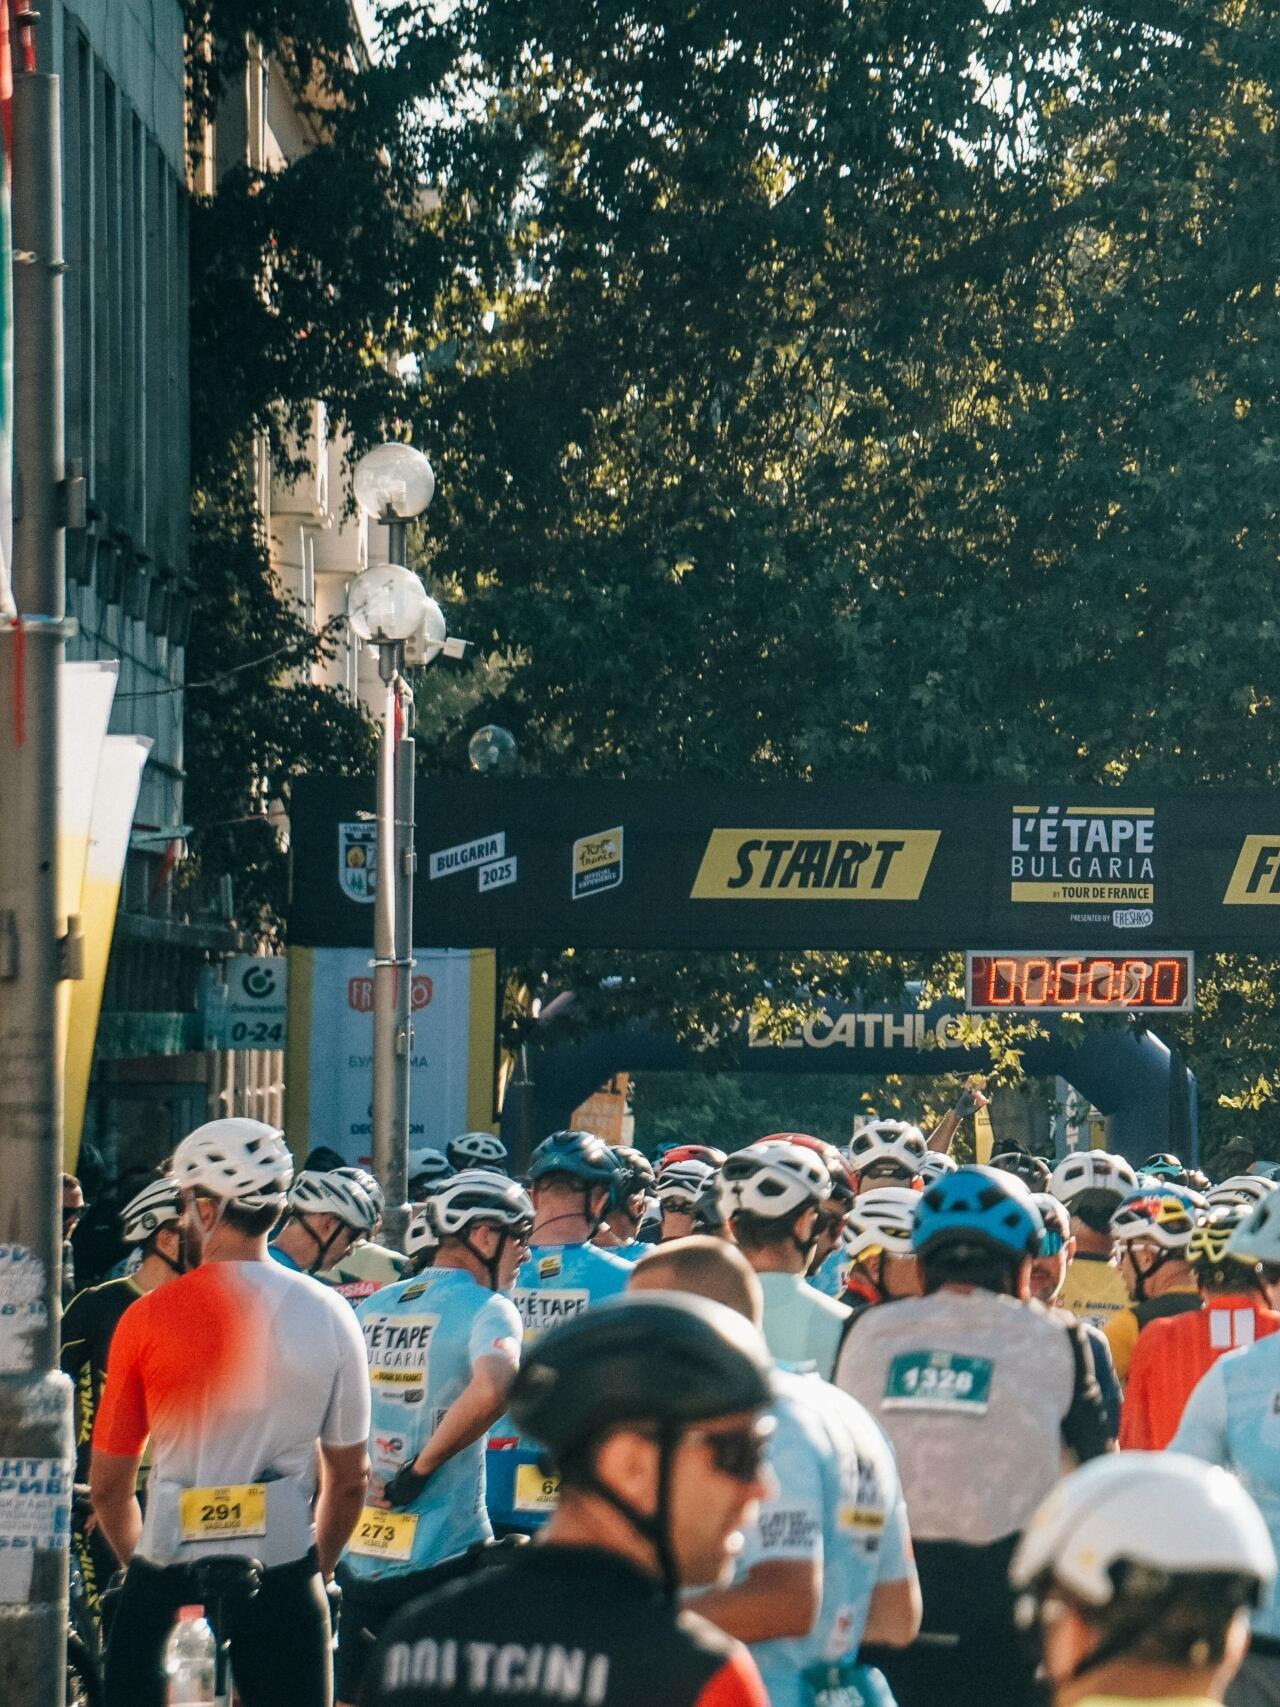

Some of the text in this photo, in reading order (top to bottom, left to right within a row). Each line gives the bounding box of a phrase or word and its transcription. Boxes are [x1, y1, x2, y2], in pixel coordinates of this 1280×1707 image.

[1012, 807, 1155, 853] L'ÉTAPE
[437, 840, 498, 872] BULGARIA
[482, 864, 513, 885] 2025
[1011, 856, 1154, 878] BULGARIA
[1062, 886, 1090, 899] TOUR
[1092, 887, 1106, 899] DE
[1107, 887, 1149, 900] FRANCE
[231, 1022, 282, 1042] 0-24
[200, 1503, 241, 1521] 291
[360, 1523, 397, 1541] 273
